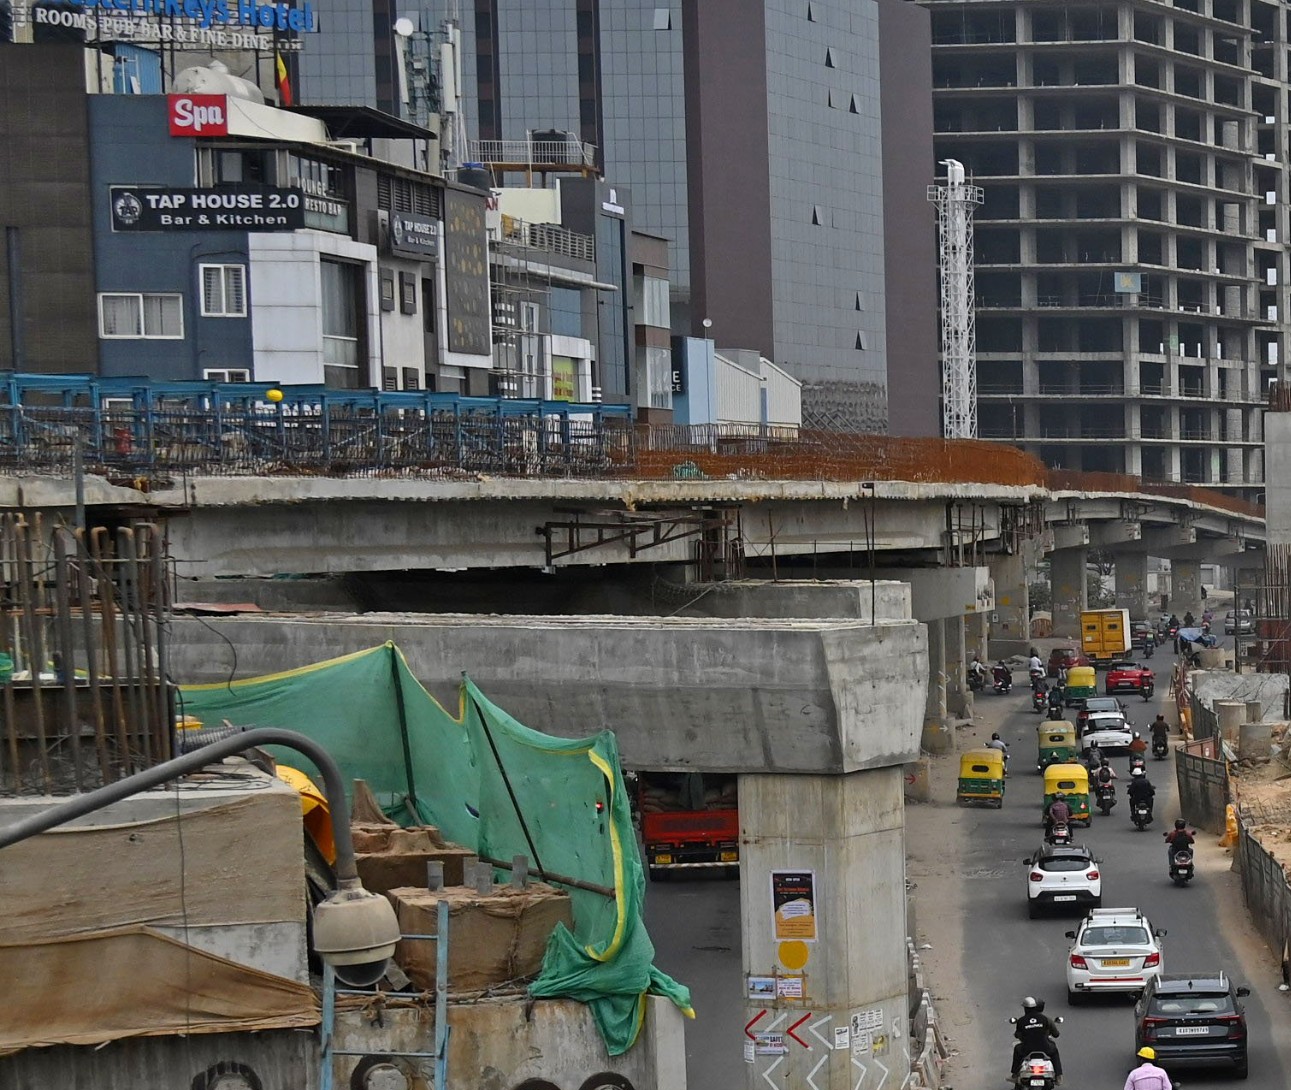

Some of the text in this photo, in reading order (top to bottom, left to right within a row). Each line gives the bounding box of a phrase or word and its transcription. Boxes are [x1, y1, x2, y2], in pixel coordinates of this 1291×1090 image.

[36, 8, 270, 50] ROOMS PUB BAR & FINE DINE
[174, 99, 224, 131] Spa
[146, 194, 299, 209] TAP HOUSE 2.0
[305, 198, 342, 216] RESTO BAR
[161, 214, 287, 225] Bar & Kitchen
